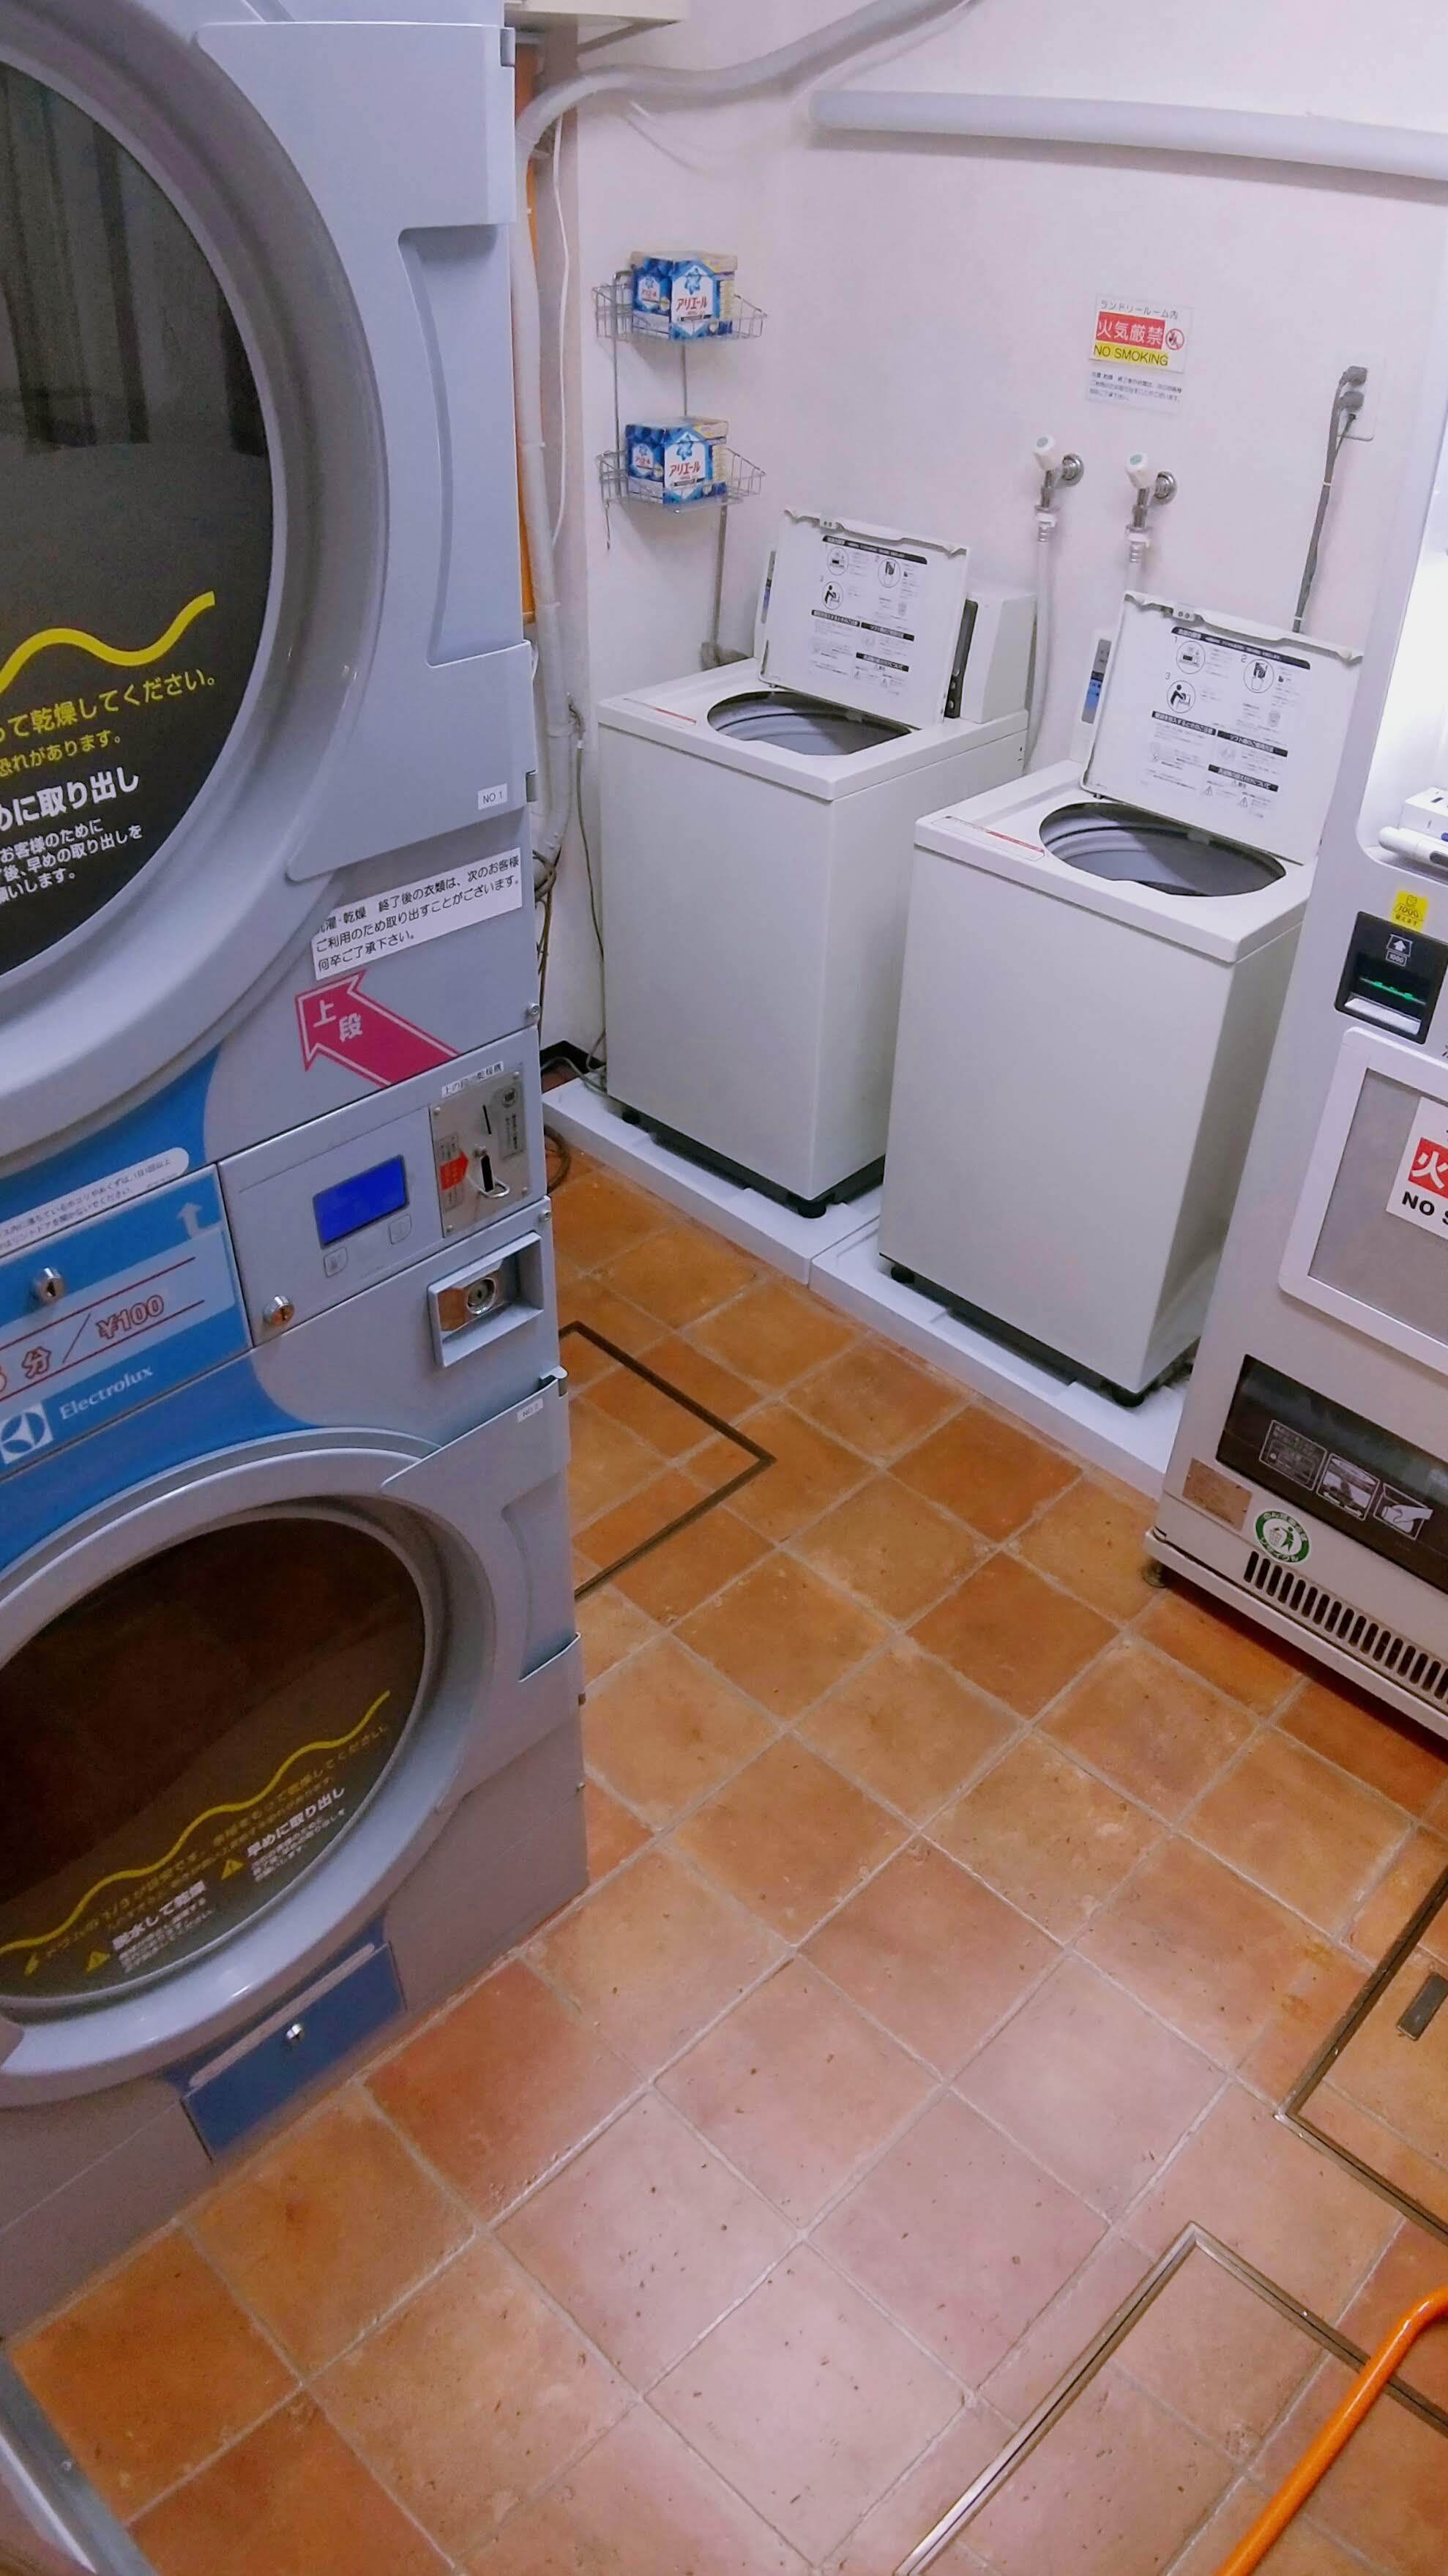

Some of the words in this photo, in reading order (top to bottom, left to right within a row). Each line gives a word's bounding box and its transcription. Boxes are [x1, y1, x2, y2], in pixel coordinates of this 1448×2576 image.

[676, 297, 707, 311] アリエール
[1097, 319, 1164, 346] 火気厳禁
[1093, 344, 1111, 357] NO
[1113, 347, 1169, 366] SMOKING
[669, 461, 701, 477] アリエール
[0, 668, 217, 742] て乾燥してください。
[483, 792, 496, 804] NO
[0, 819, 103, 863] お客様のために
[0, 824, 143, 882] 後、早めの取り出しを
[316, 875, 518, 953] ご利用のため取り出すことがございます。
[318, 931, 414, 972] 何卒ご了承下さい。
[313, 999, 364, 1043] 上段
[1401, 1190, 1435, 1216] NO
[59, 1365, 154, 1421] Electrolux
